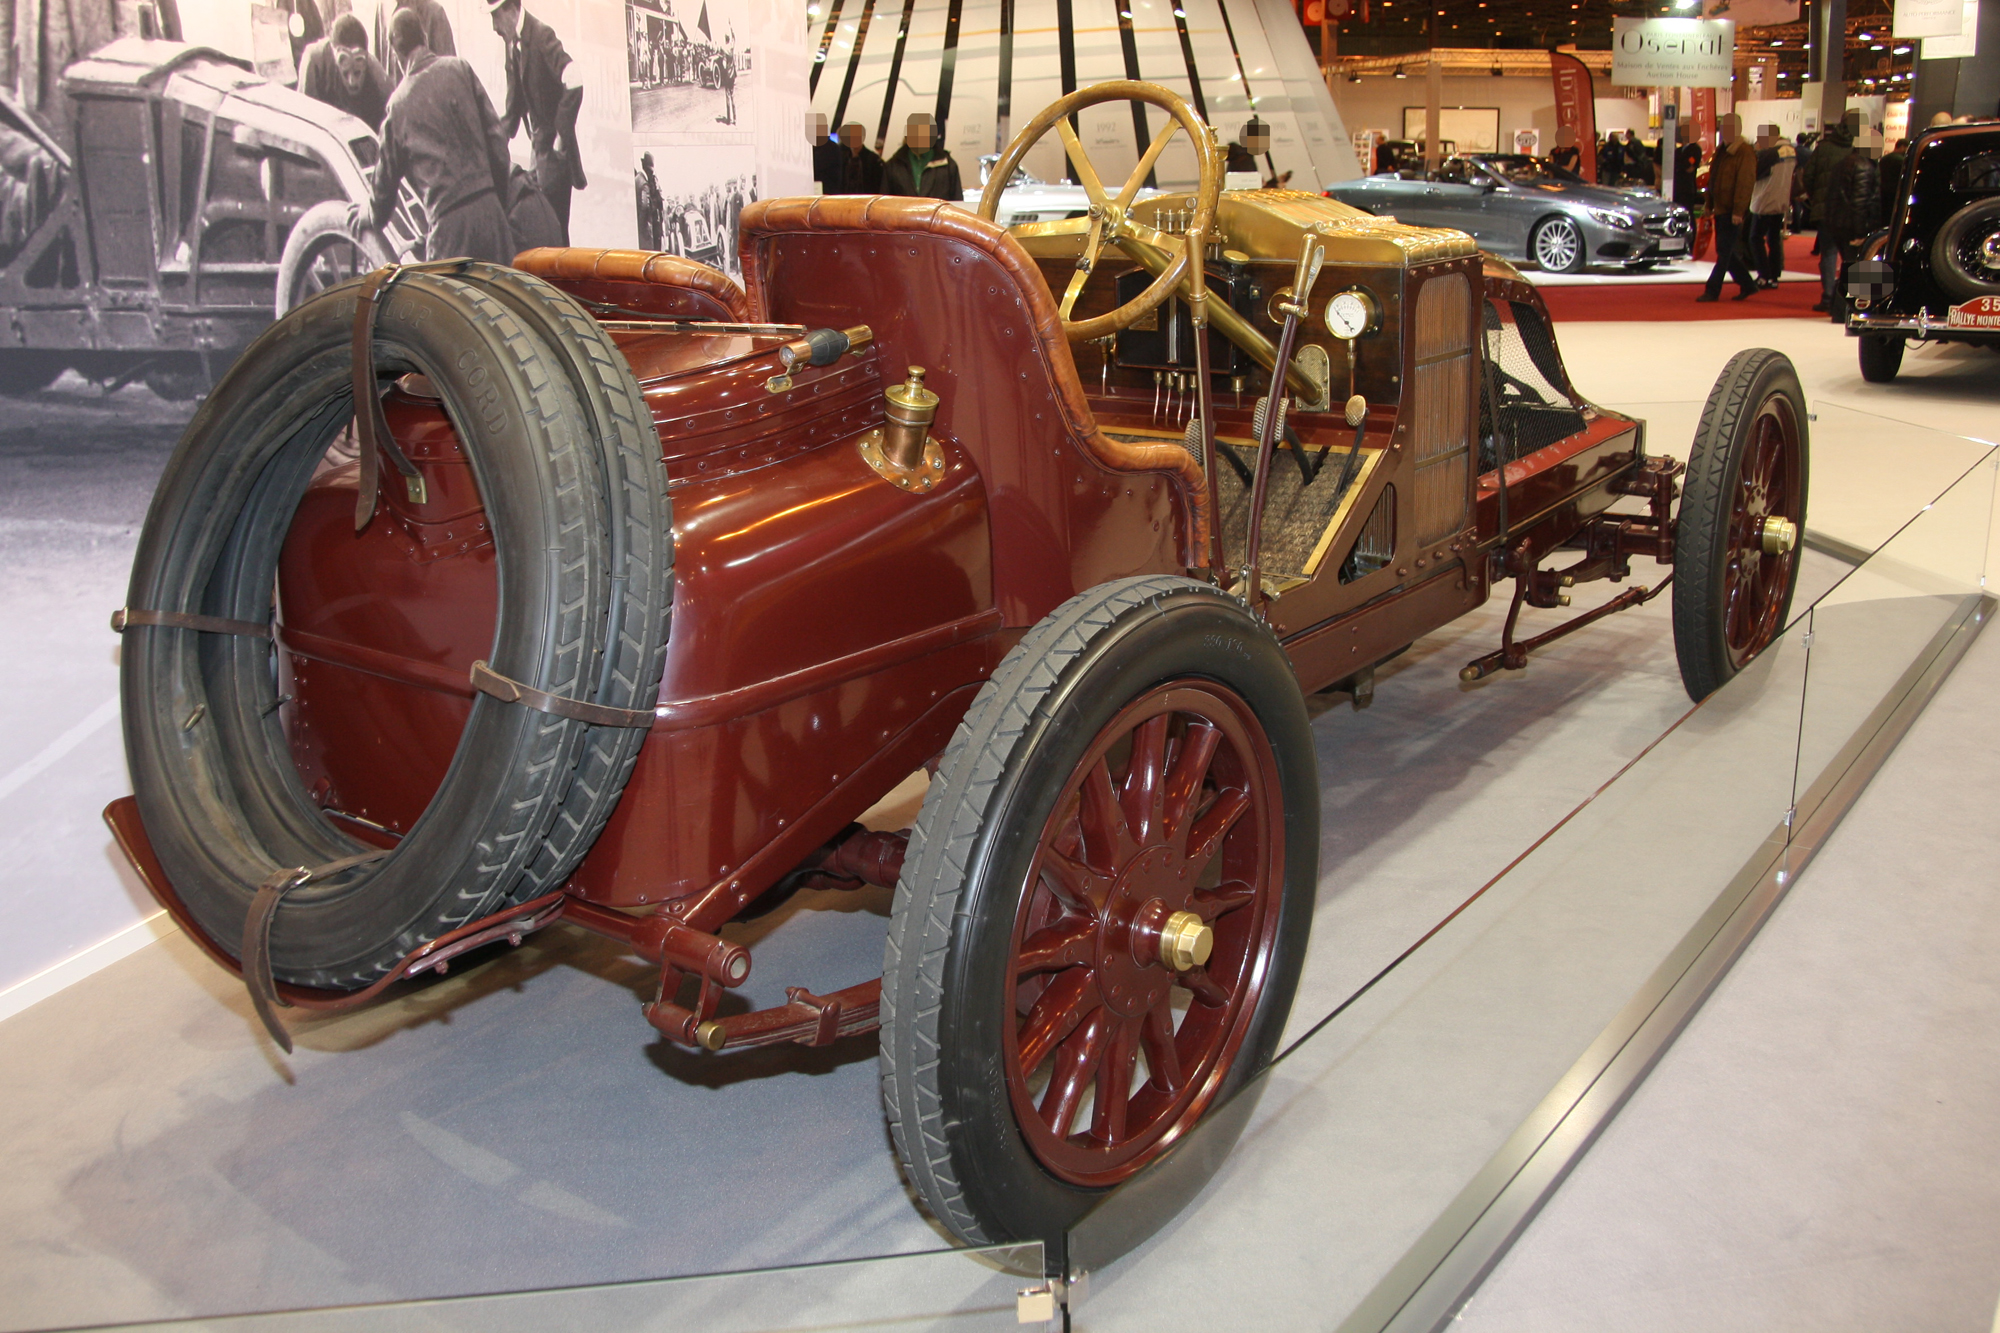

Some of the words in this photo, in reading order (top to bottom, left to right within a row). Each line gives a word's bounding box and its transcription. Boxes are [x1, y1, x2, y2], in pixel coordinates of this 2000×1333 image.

[1656, 62, 1680, 70] Ventes
[1697, 62, 1728, 71] Enchères
[1096, 121, 1116, 132] 1992
[1950, 309, 1976, 326] RALLYE
[1976, 315, 2000, 326] MONTE
[457, 349, 509, 435] CORD
